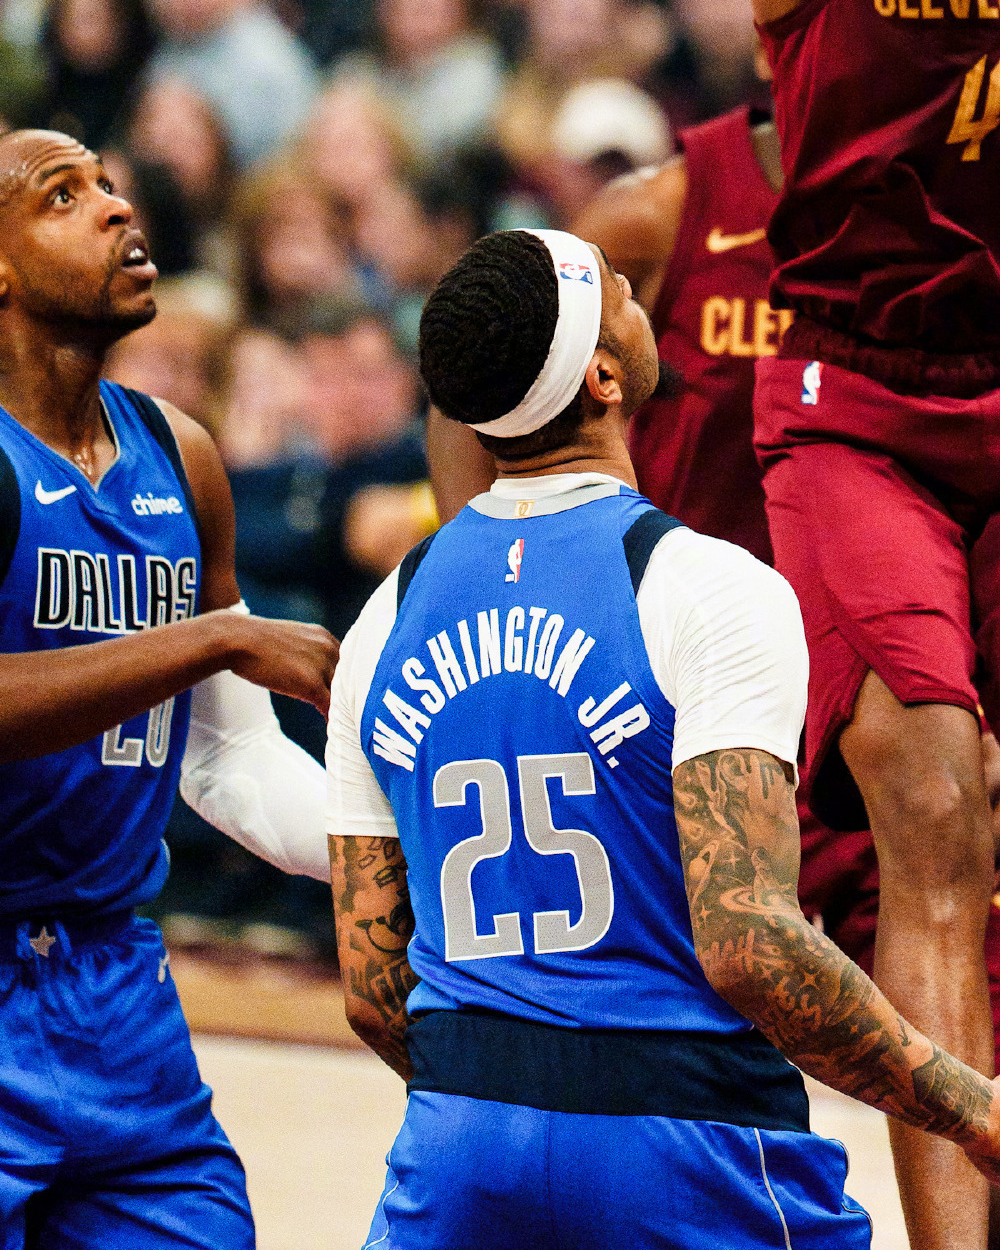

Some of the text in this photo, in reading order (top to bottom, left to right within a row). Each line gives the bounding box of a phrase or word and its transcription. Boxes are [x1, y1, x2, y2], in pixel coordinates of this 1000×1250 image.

[131, 492, 183, 516] chime
[34, 547, 196, 635] DALLAS
[373, 606, 651, 772] WASHINGTON JR.
[433, 752, 614, 962] 25
